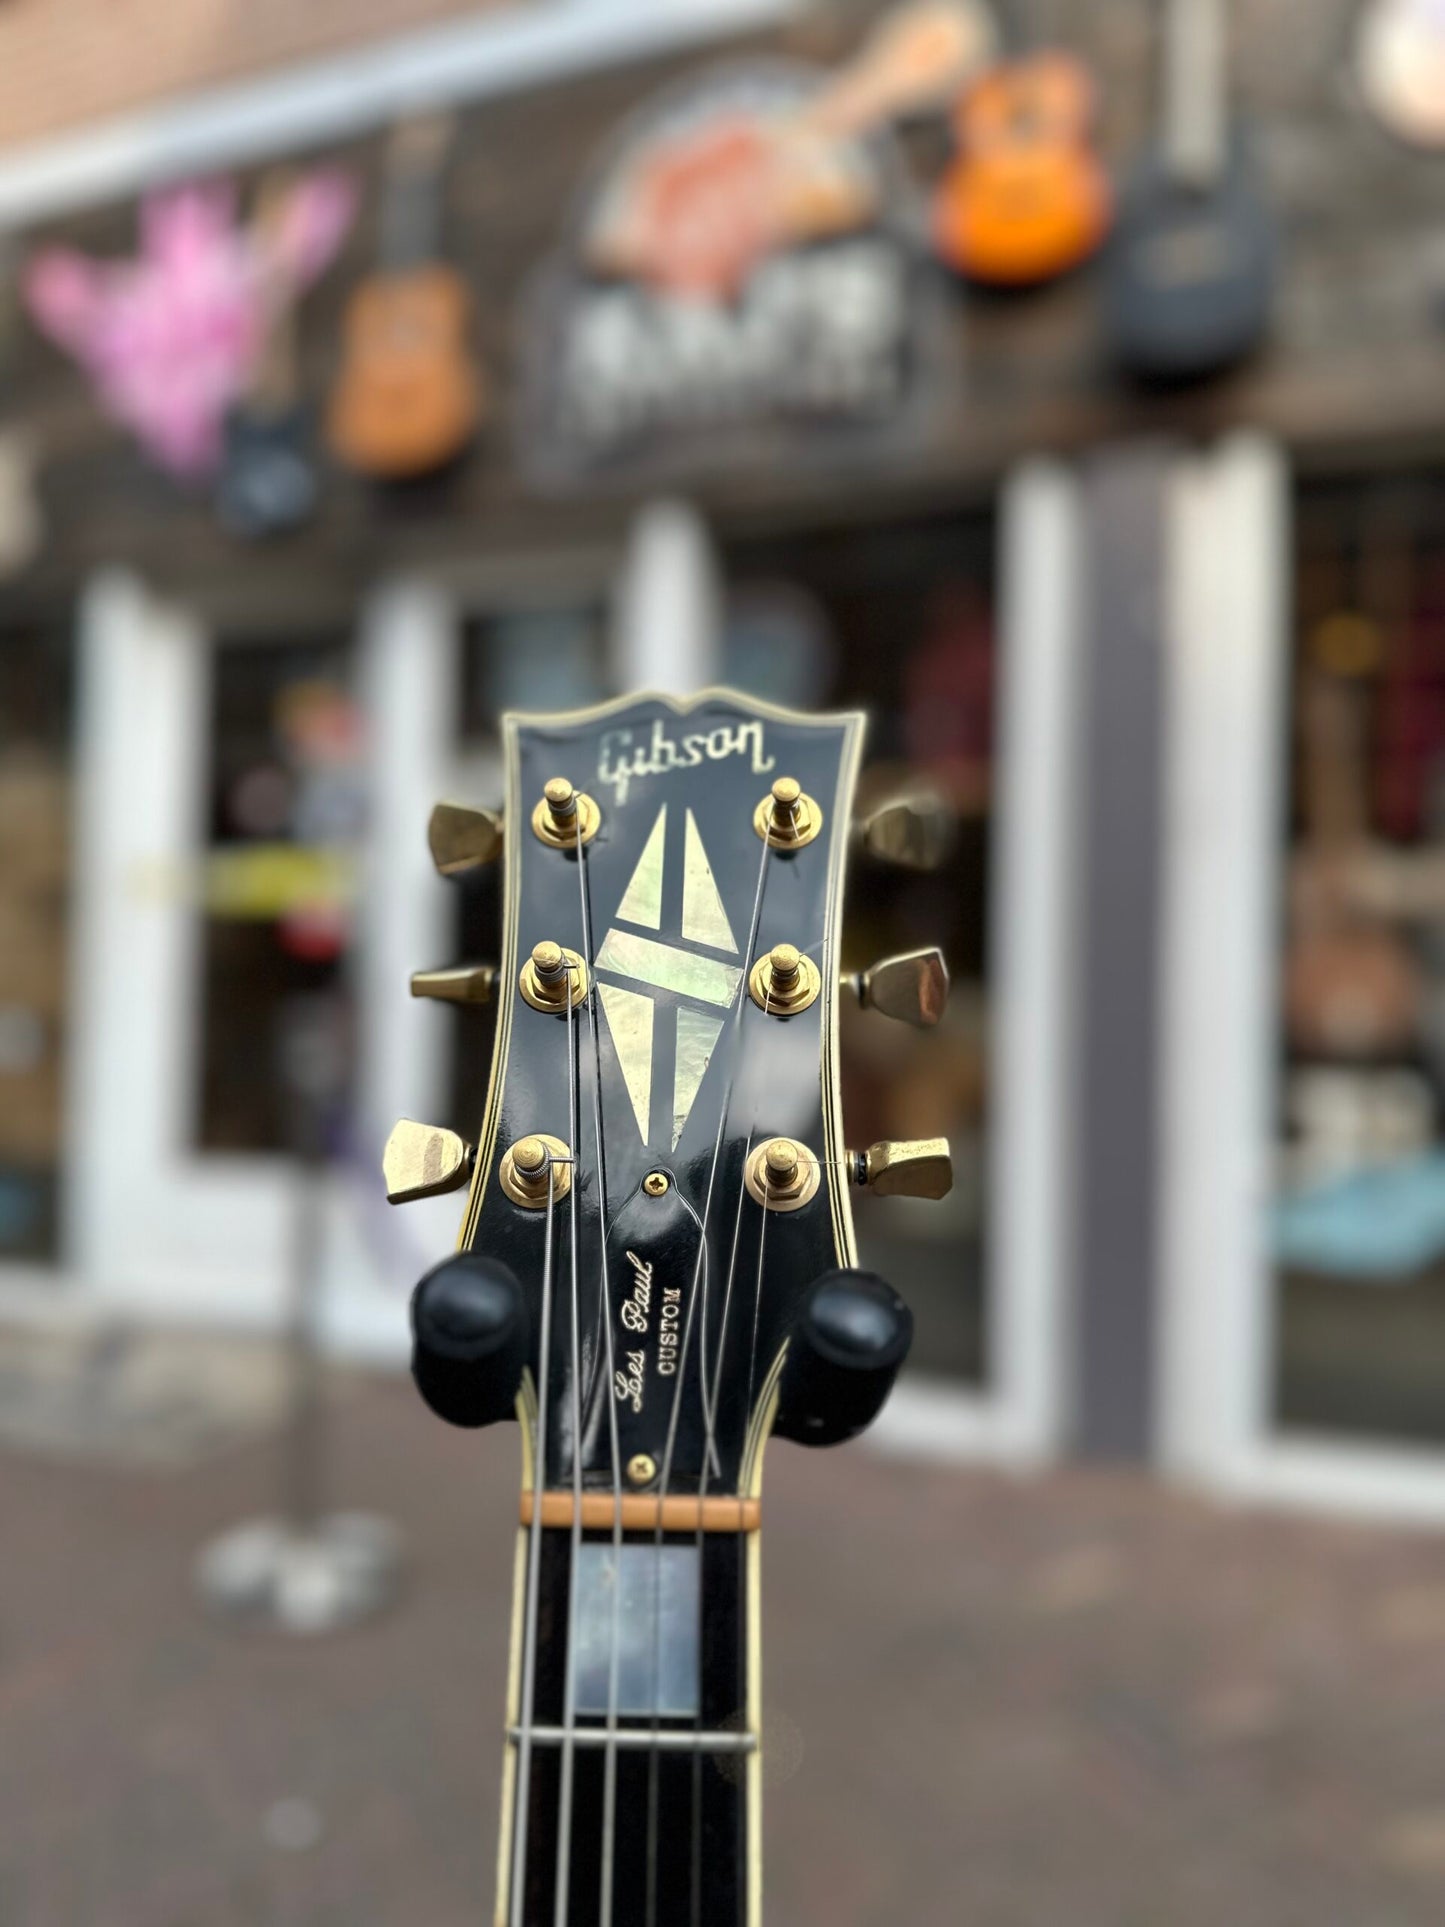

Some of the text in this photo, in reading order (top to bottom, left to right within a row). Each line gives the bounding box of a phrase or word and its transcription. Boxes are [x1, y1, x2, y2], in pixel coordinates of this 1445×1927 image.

[598, 719, 775, 807] Gibson
[614, 1250, 653, 1413] Les Paul
[657, 1287, 682, 1376] CUSTOM
